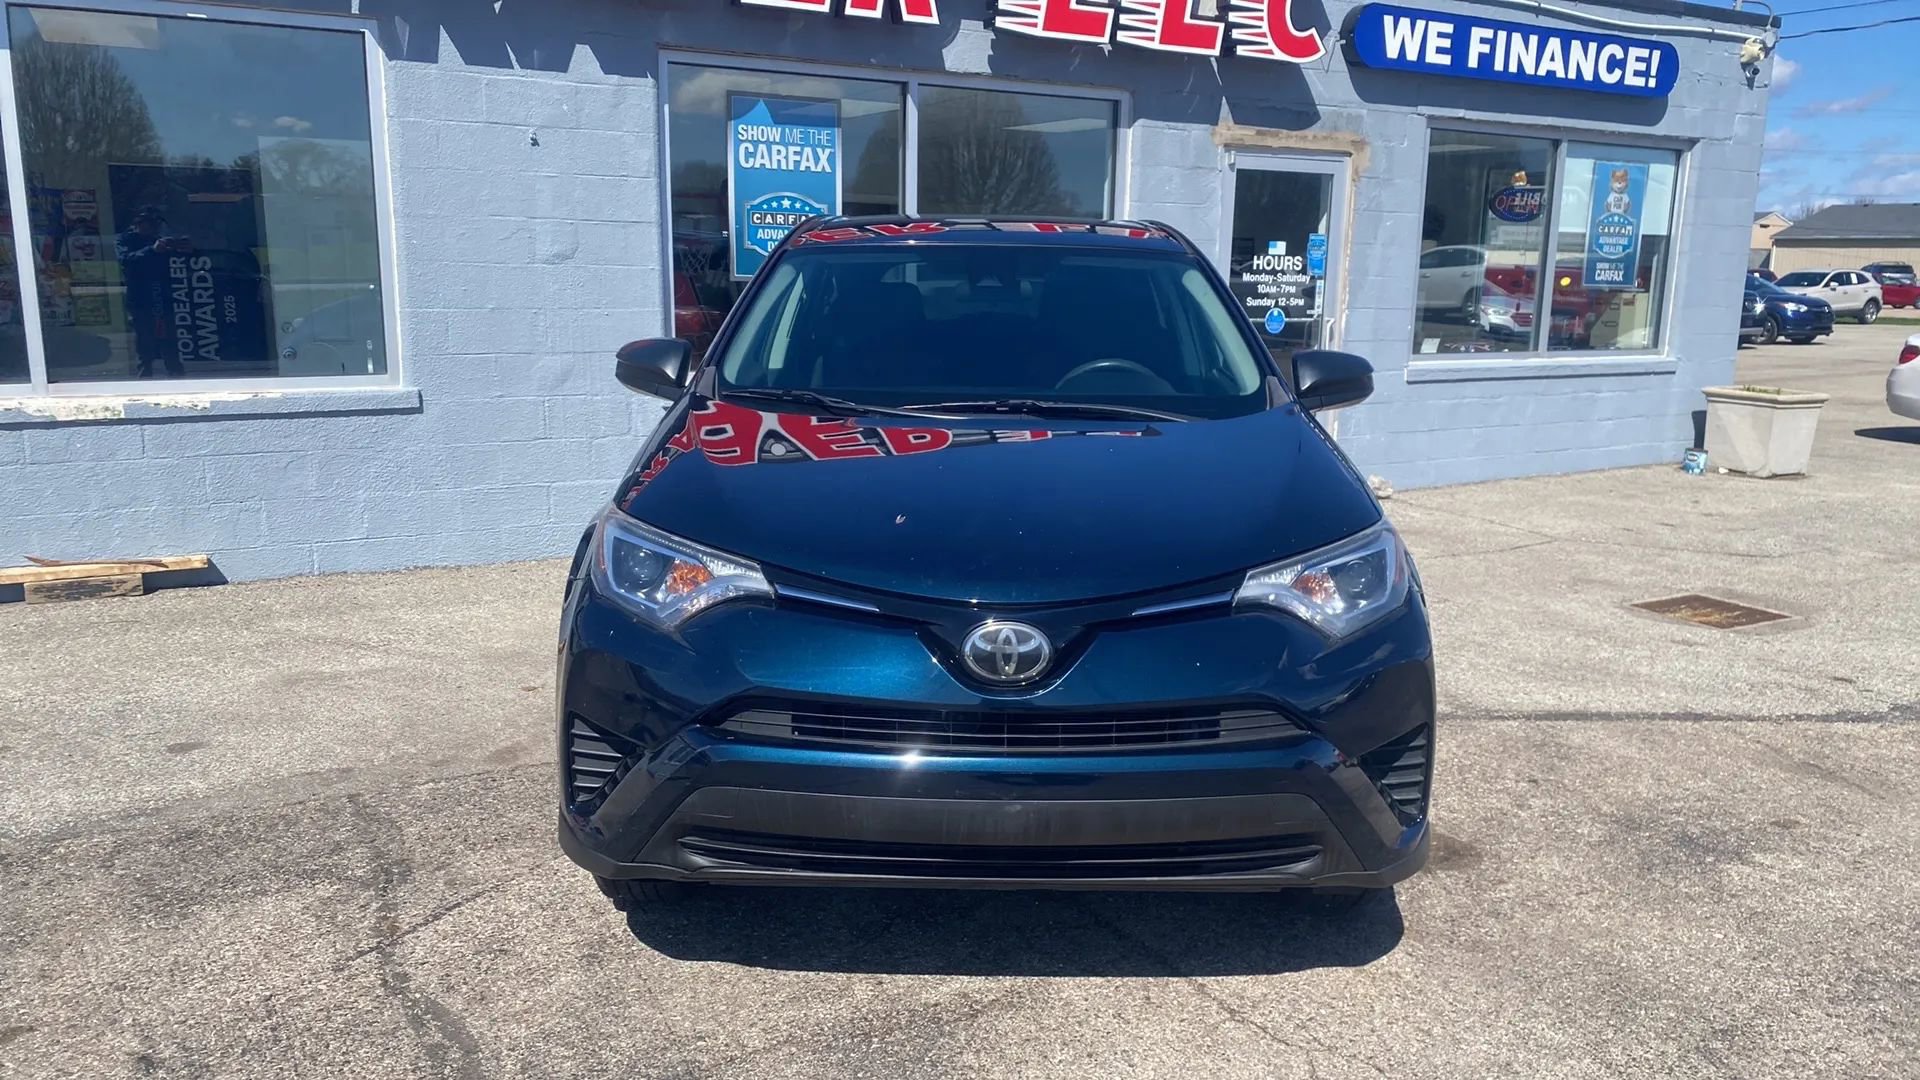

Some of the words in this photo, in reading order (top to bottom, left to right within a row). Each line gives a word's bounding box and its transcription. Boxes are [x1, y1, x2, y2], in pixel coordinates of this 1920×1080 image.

[1383, 15, 1455, 65] WE
[1467, 26, 1661, 88] FINANCE!
[738, 124, 781, 142] SHOW
[785, 127, 804, 144] ME
[807, 129, 831, 146] THE
[738, 142, 832, 173] CARFAX
[753, 213, 807, 225] CARFA
[1253, 255, 1303, 271] HOURS
[1595, 269, 1624, 281] CARFAX
[169, 256, 192, 325] DEALER
[1242, 273, 1310, 284] Monday-Saturday
[189, 256, 221, 361] AWARDS
[224, 295, 238, 323] 2025
[1246, 297, 1276, 308] Sunday
[177, 328, 195, 361] TOP
